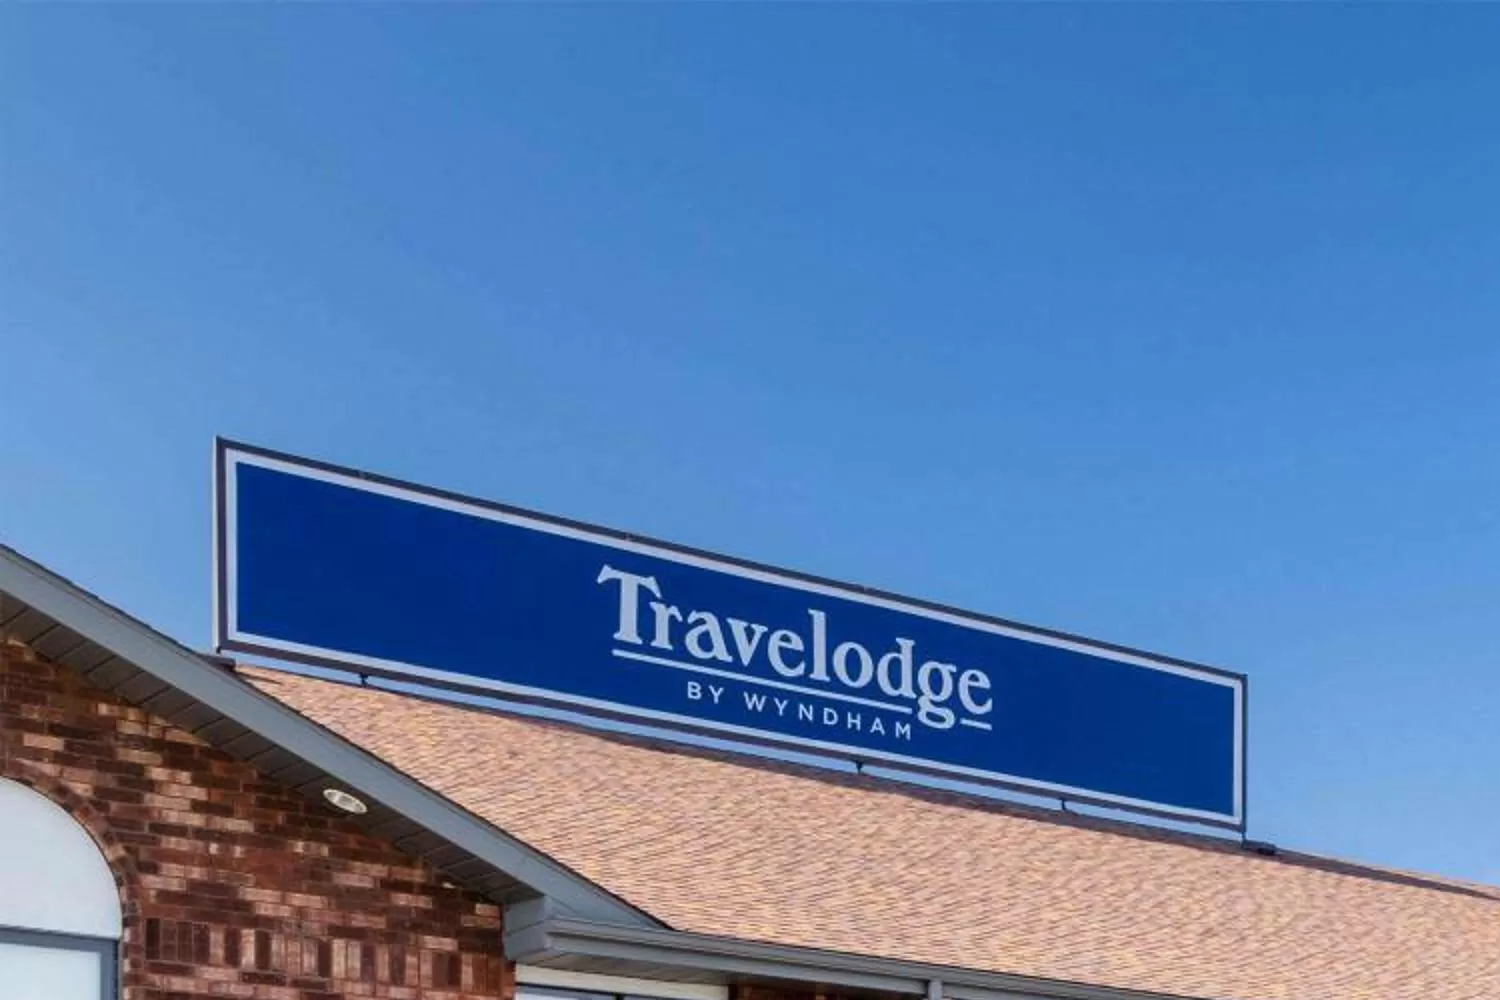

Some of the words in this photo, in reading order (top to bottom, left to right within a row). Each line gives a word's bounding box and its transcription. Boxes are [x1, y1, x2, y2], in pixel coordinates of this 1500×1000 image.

[597, 565, 993, 729] Travelodge
[686, 681, 725, 703] BY
[743, 691, 912, 740] WYNDHAM
